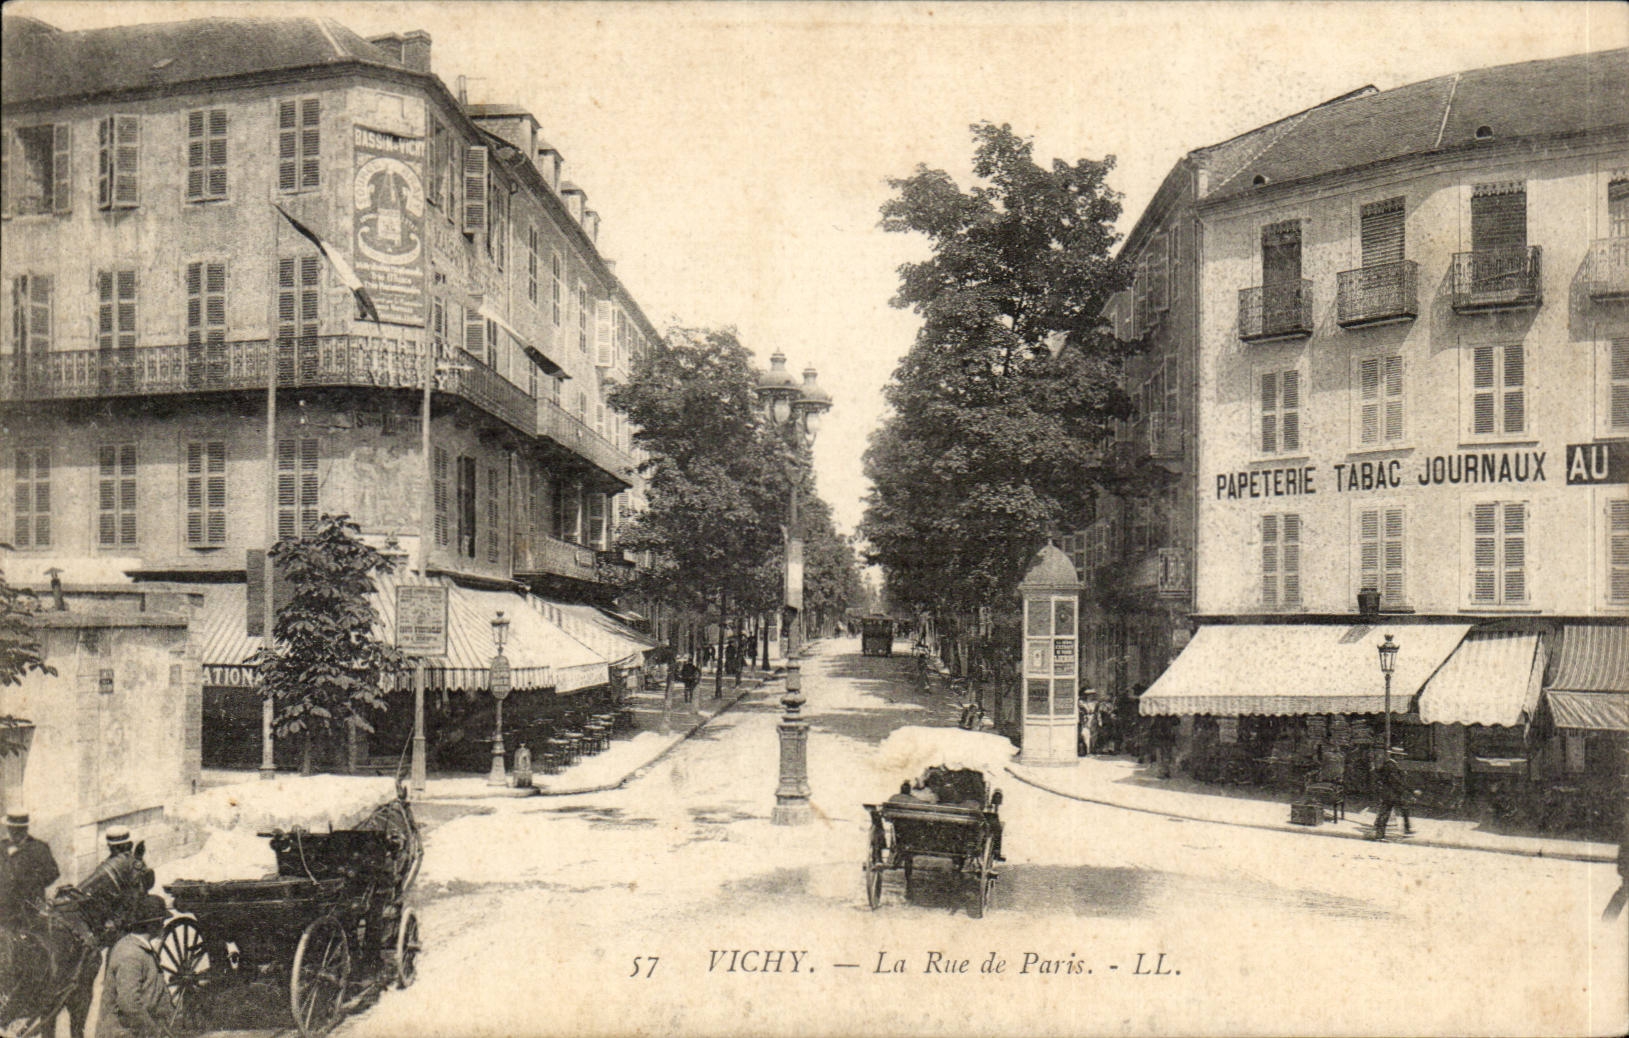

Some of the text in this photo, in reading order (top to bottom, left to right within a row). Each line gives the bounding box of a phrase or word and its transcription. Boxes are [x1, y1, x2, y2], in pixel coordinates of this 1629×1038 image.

[354, 128, 393, 152] BASSIN
[1217, 451, 1547, 500] PAPETERIE TABAC JOURNAUX
[1569, 445, 1609, 481] AU
